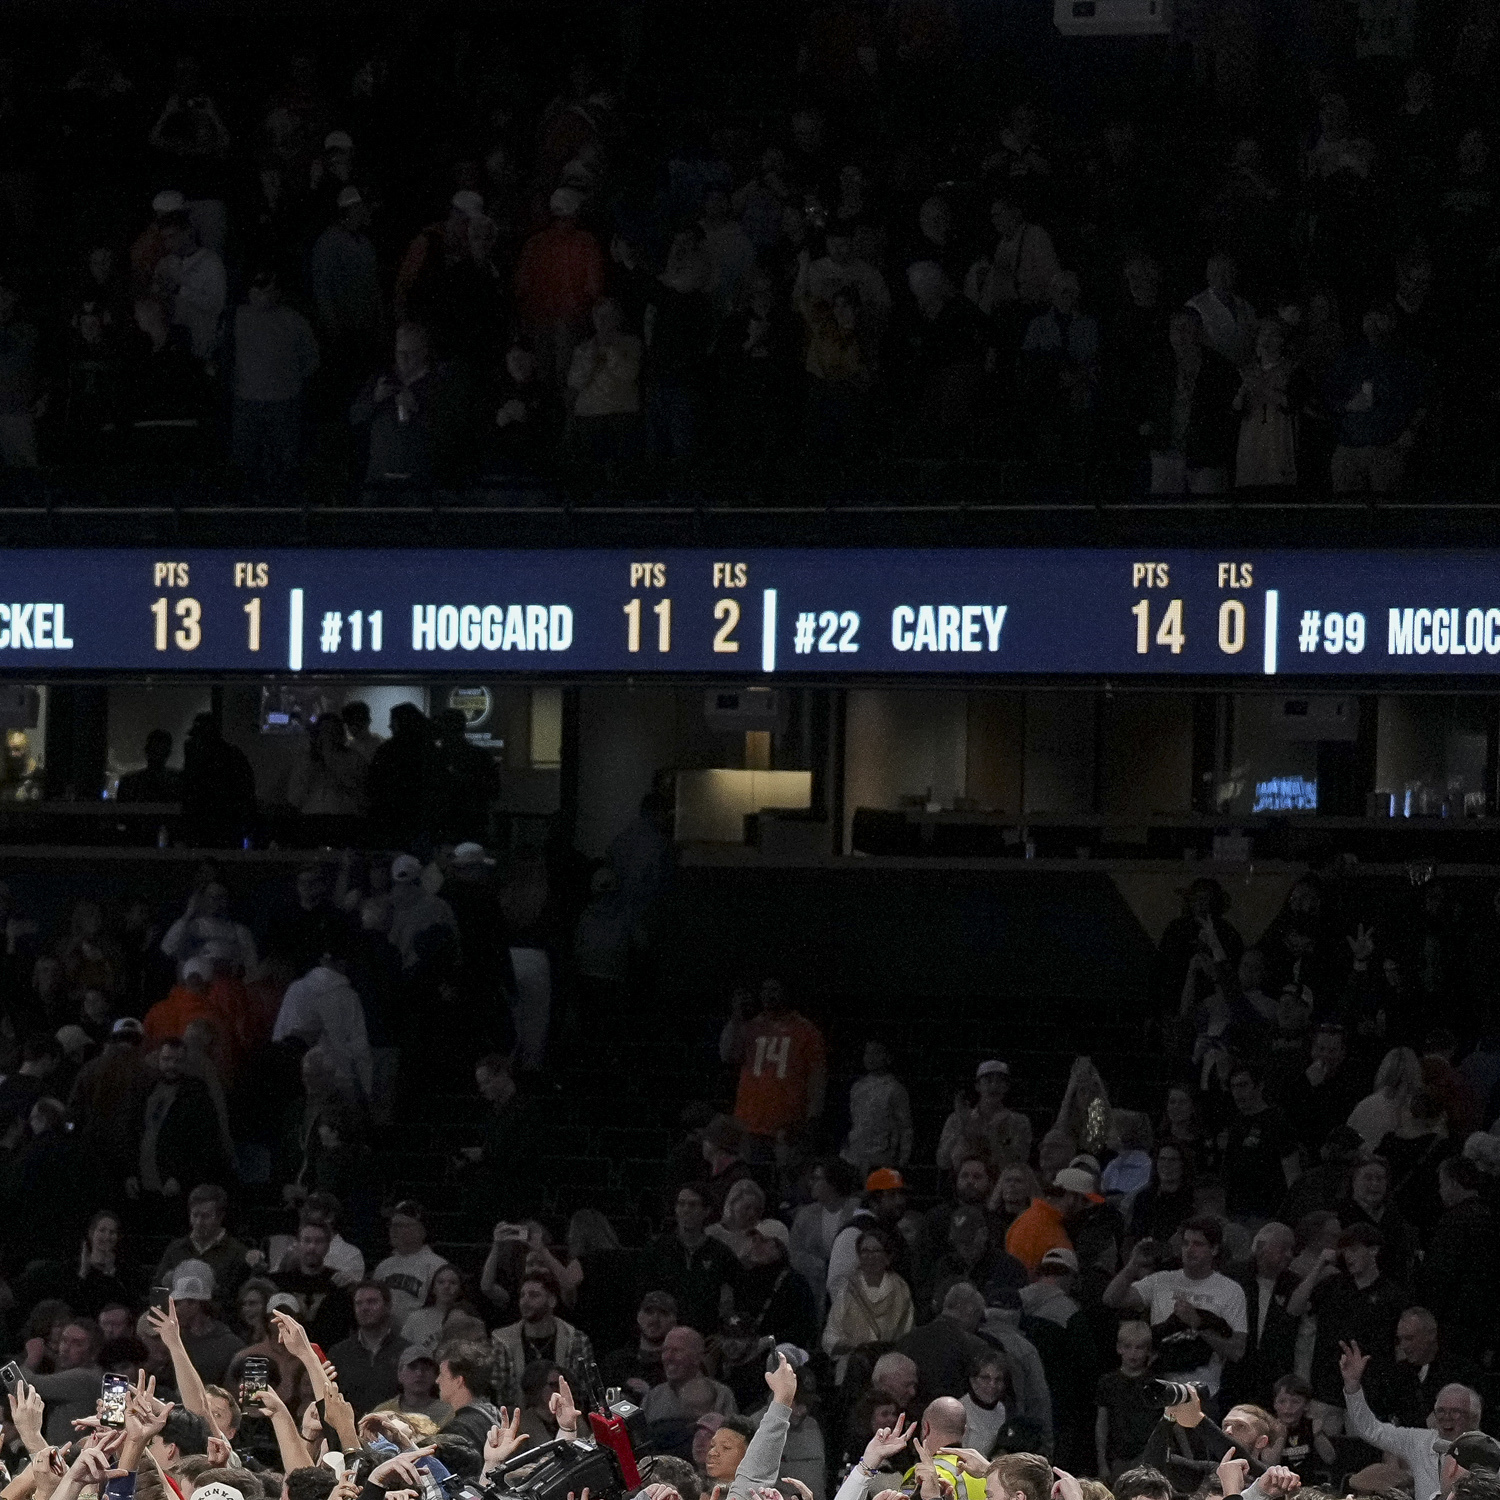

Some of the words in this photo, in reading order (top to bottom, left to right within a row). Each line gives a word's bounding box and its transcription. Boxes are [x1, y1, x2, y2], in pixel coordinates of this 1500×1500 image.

[154, 562, 189, 588] PTS
[235, 562, 269, 588] FLS
[630, 562, 666, 588] PTS
[713, 562, 748, 589] FLS
[1133, 562, 1169, 588] PTS
[1218, 562, 1253, 589] FLS
[150, 597, 202, 651] 13
[244, 597, 261, 652] 1
[319, 609, 383, 654] #11
[411, 604, 574, 652] HOGGARD
[623, 598, 671, 653] 11
[713, 598, 740, 653] 2
[793, 610, 860, 655] #22
[891, 605, 1008, 652] CAREY
[1131, 599, 1185, 654] 14
[1218, 599, 1246, 655] 0
[1298, 609, 1366, 655] #99
[1387, 607, 1500, 655] MCGLOC
[753, 1036, 791, 1079] 14
